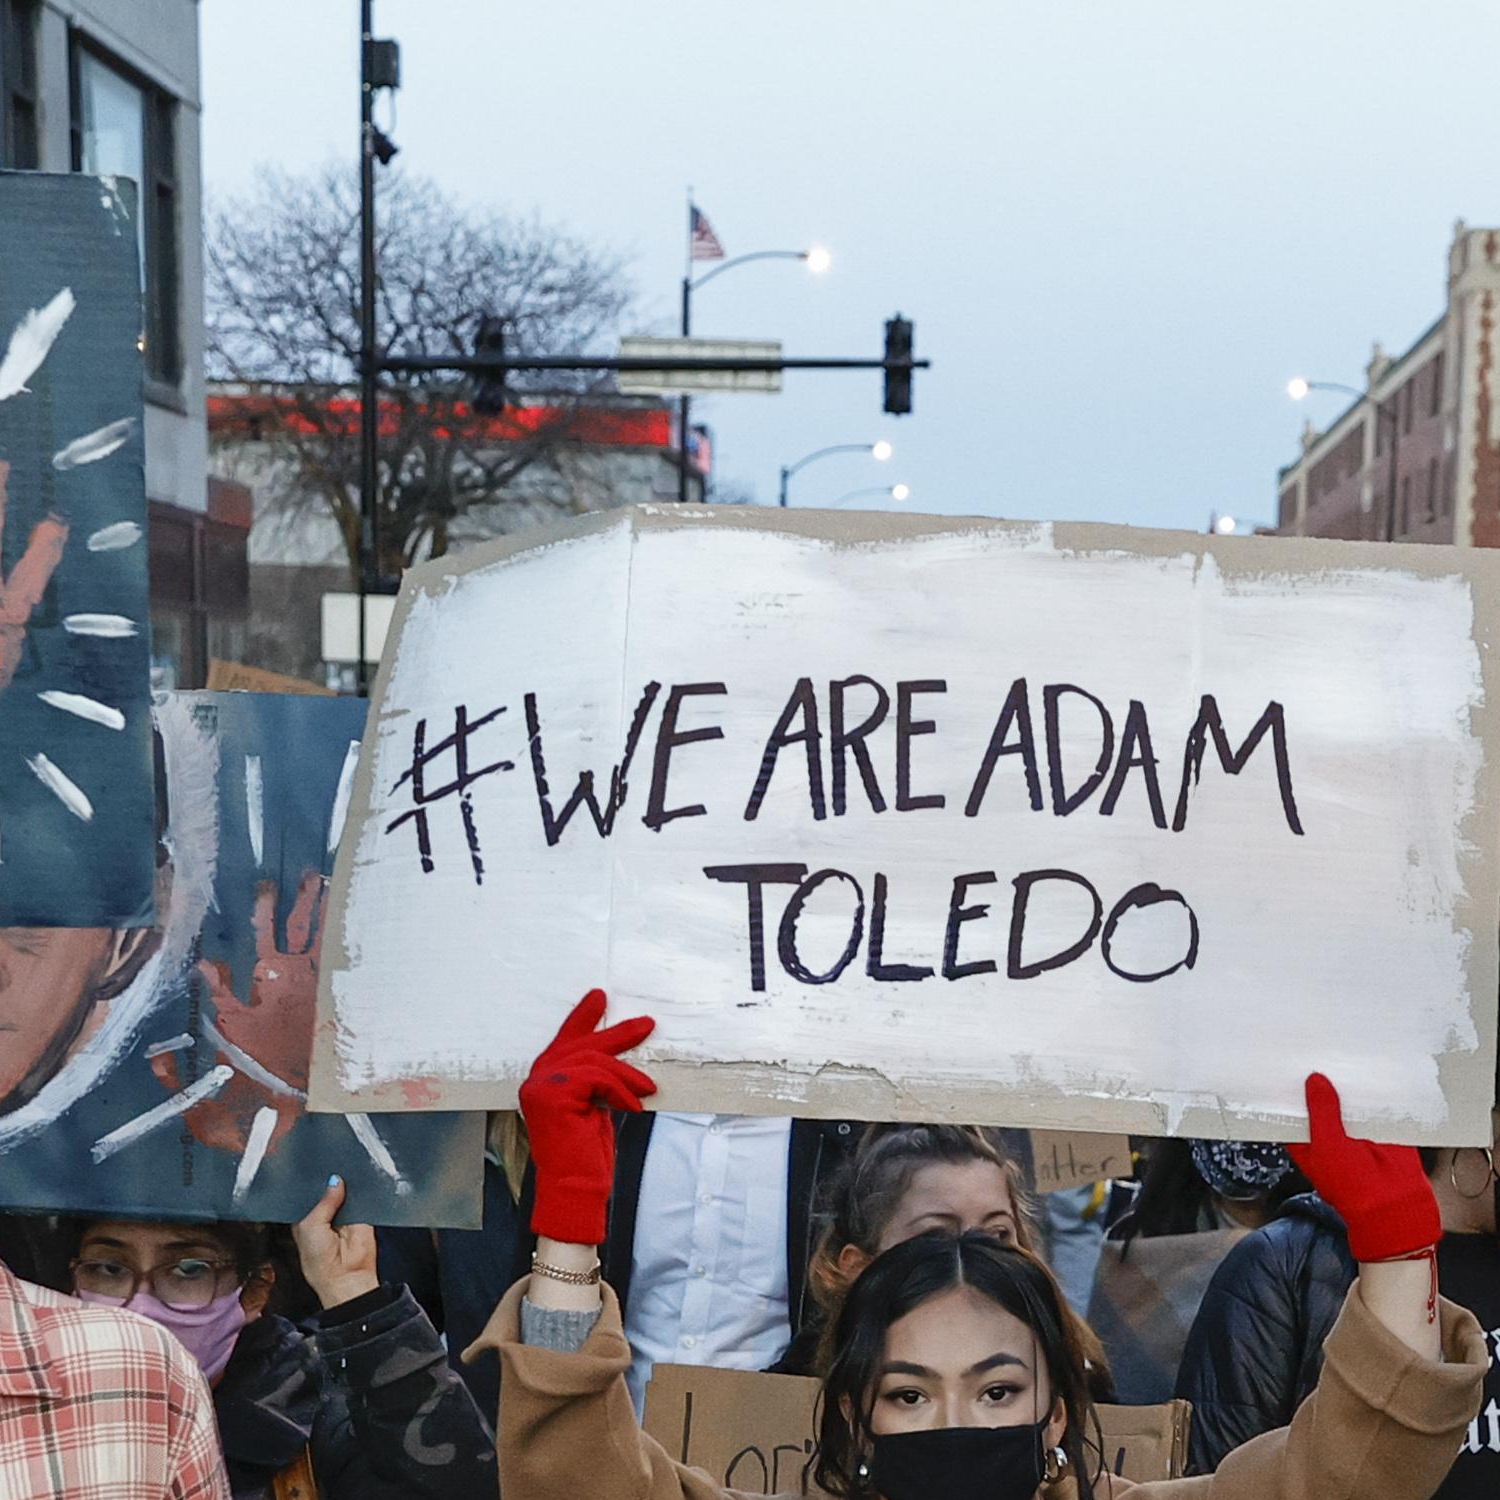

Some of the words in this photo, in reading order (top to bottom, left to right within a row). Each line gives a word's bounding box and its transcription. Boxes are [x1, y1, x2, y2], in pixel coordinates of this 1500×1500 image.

[385, 679, 728, 885] #WE
[743, 674, 947, 822] ARE
[964, 677, 1305, 835] ADAM
[702, 861, 1199, 993] TOLEDO
